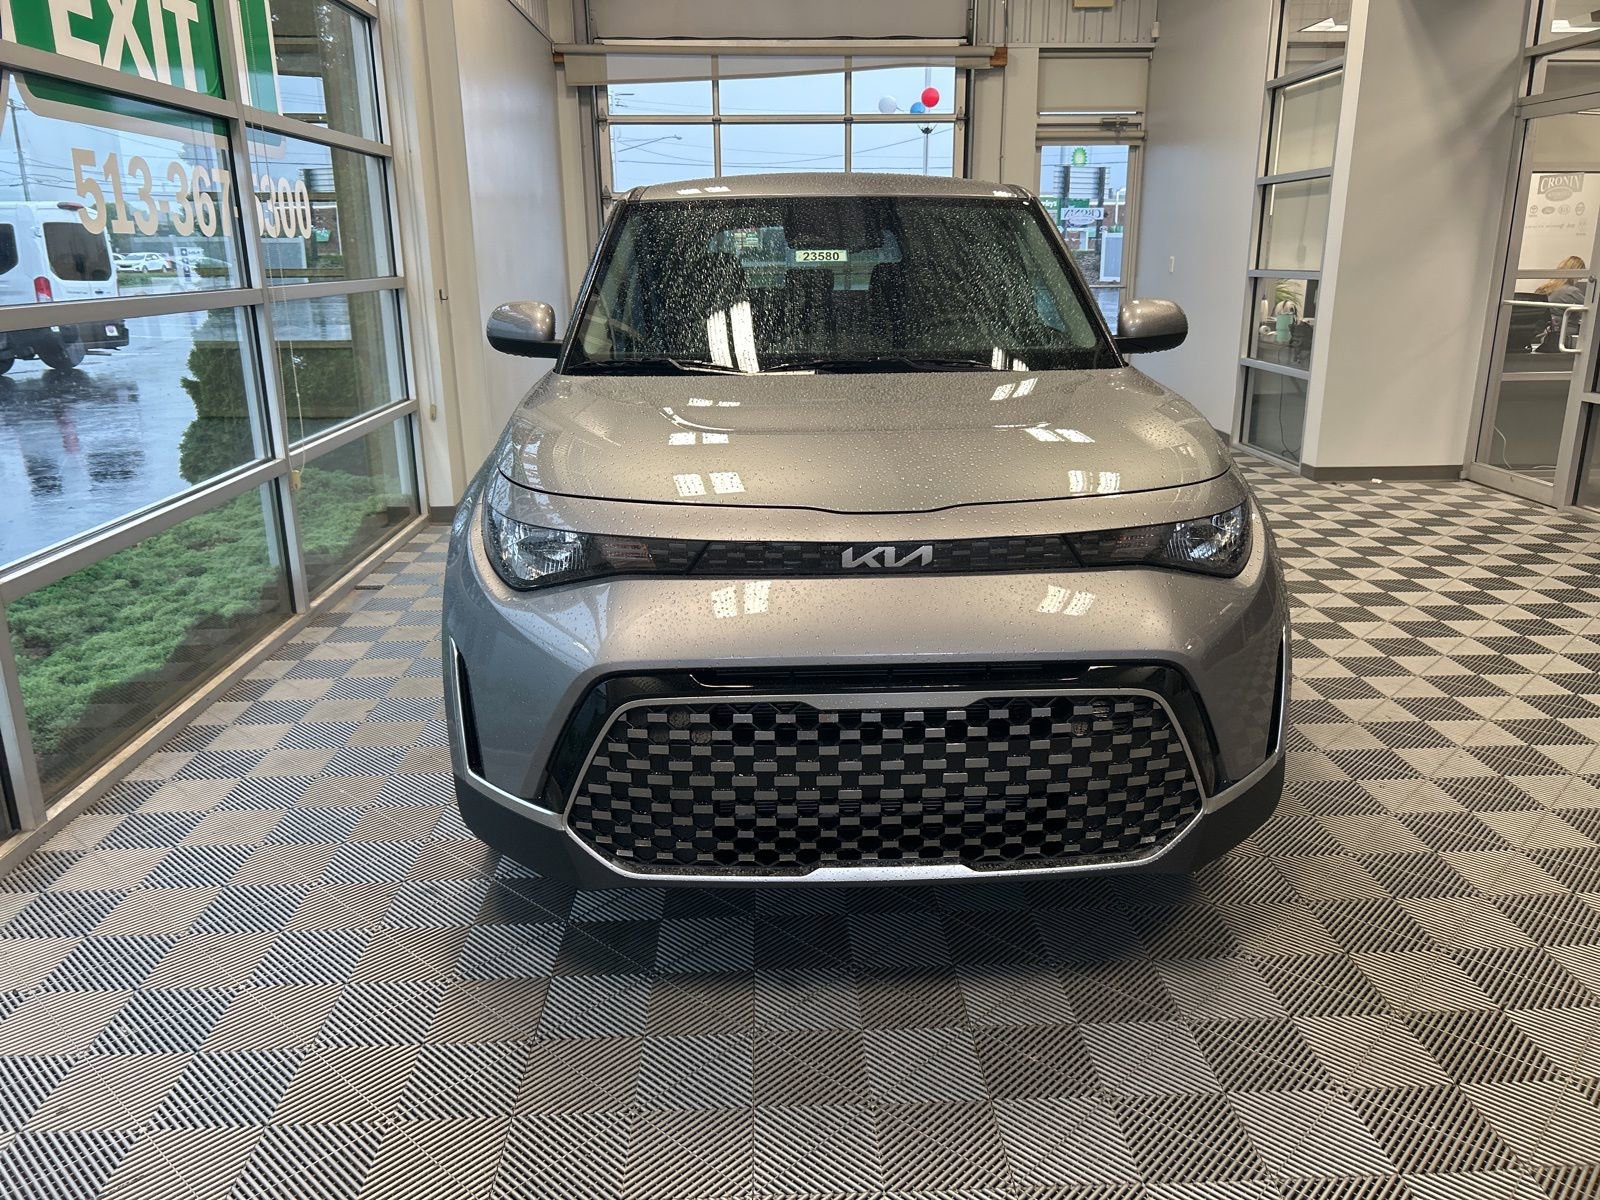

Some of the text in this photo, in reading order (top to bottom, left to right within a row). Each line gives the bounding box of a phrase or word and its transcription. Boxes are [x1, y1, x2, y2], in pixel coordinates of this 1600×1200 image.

[49, 0, 199, 93] EXIT
[1540, 175, 1581, 192] CRONIN
[803, 252, 840, 261] 23580
[842, 545, 933, 568] KIA
